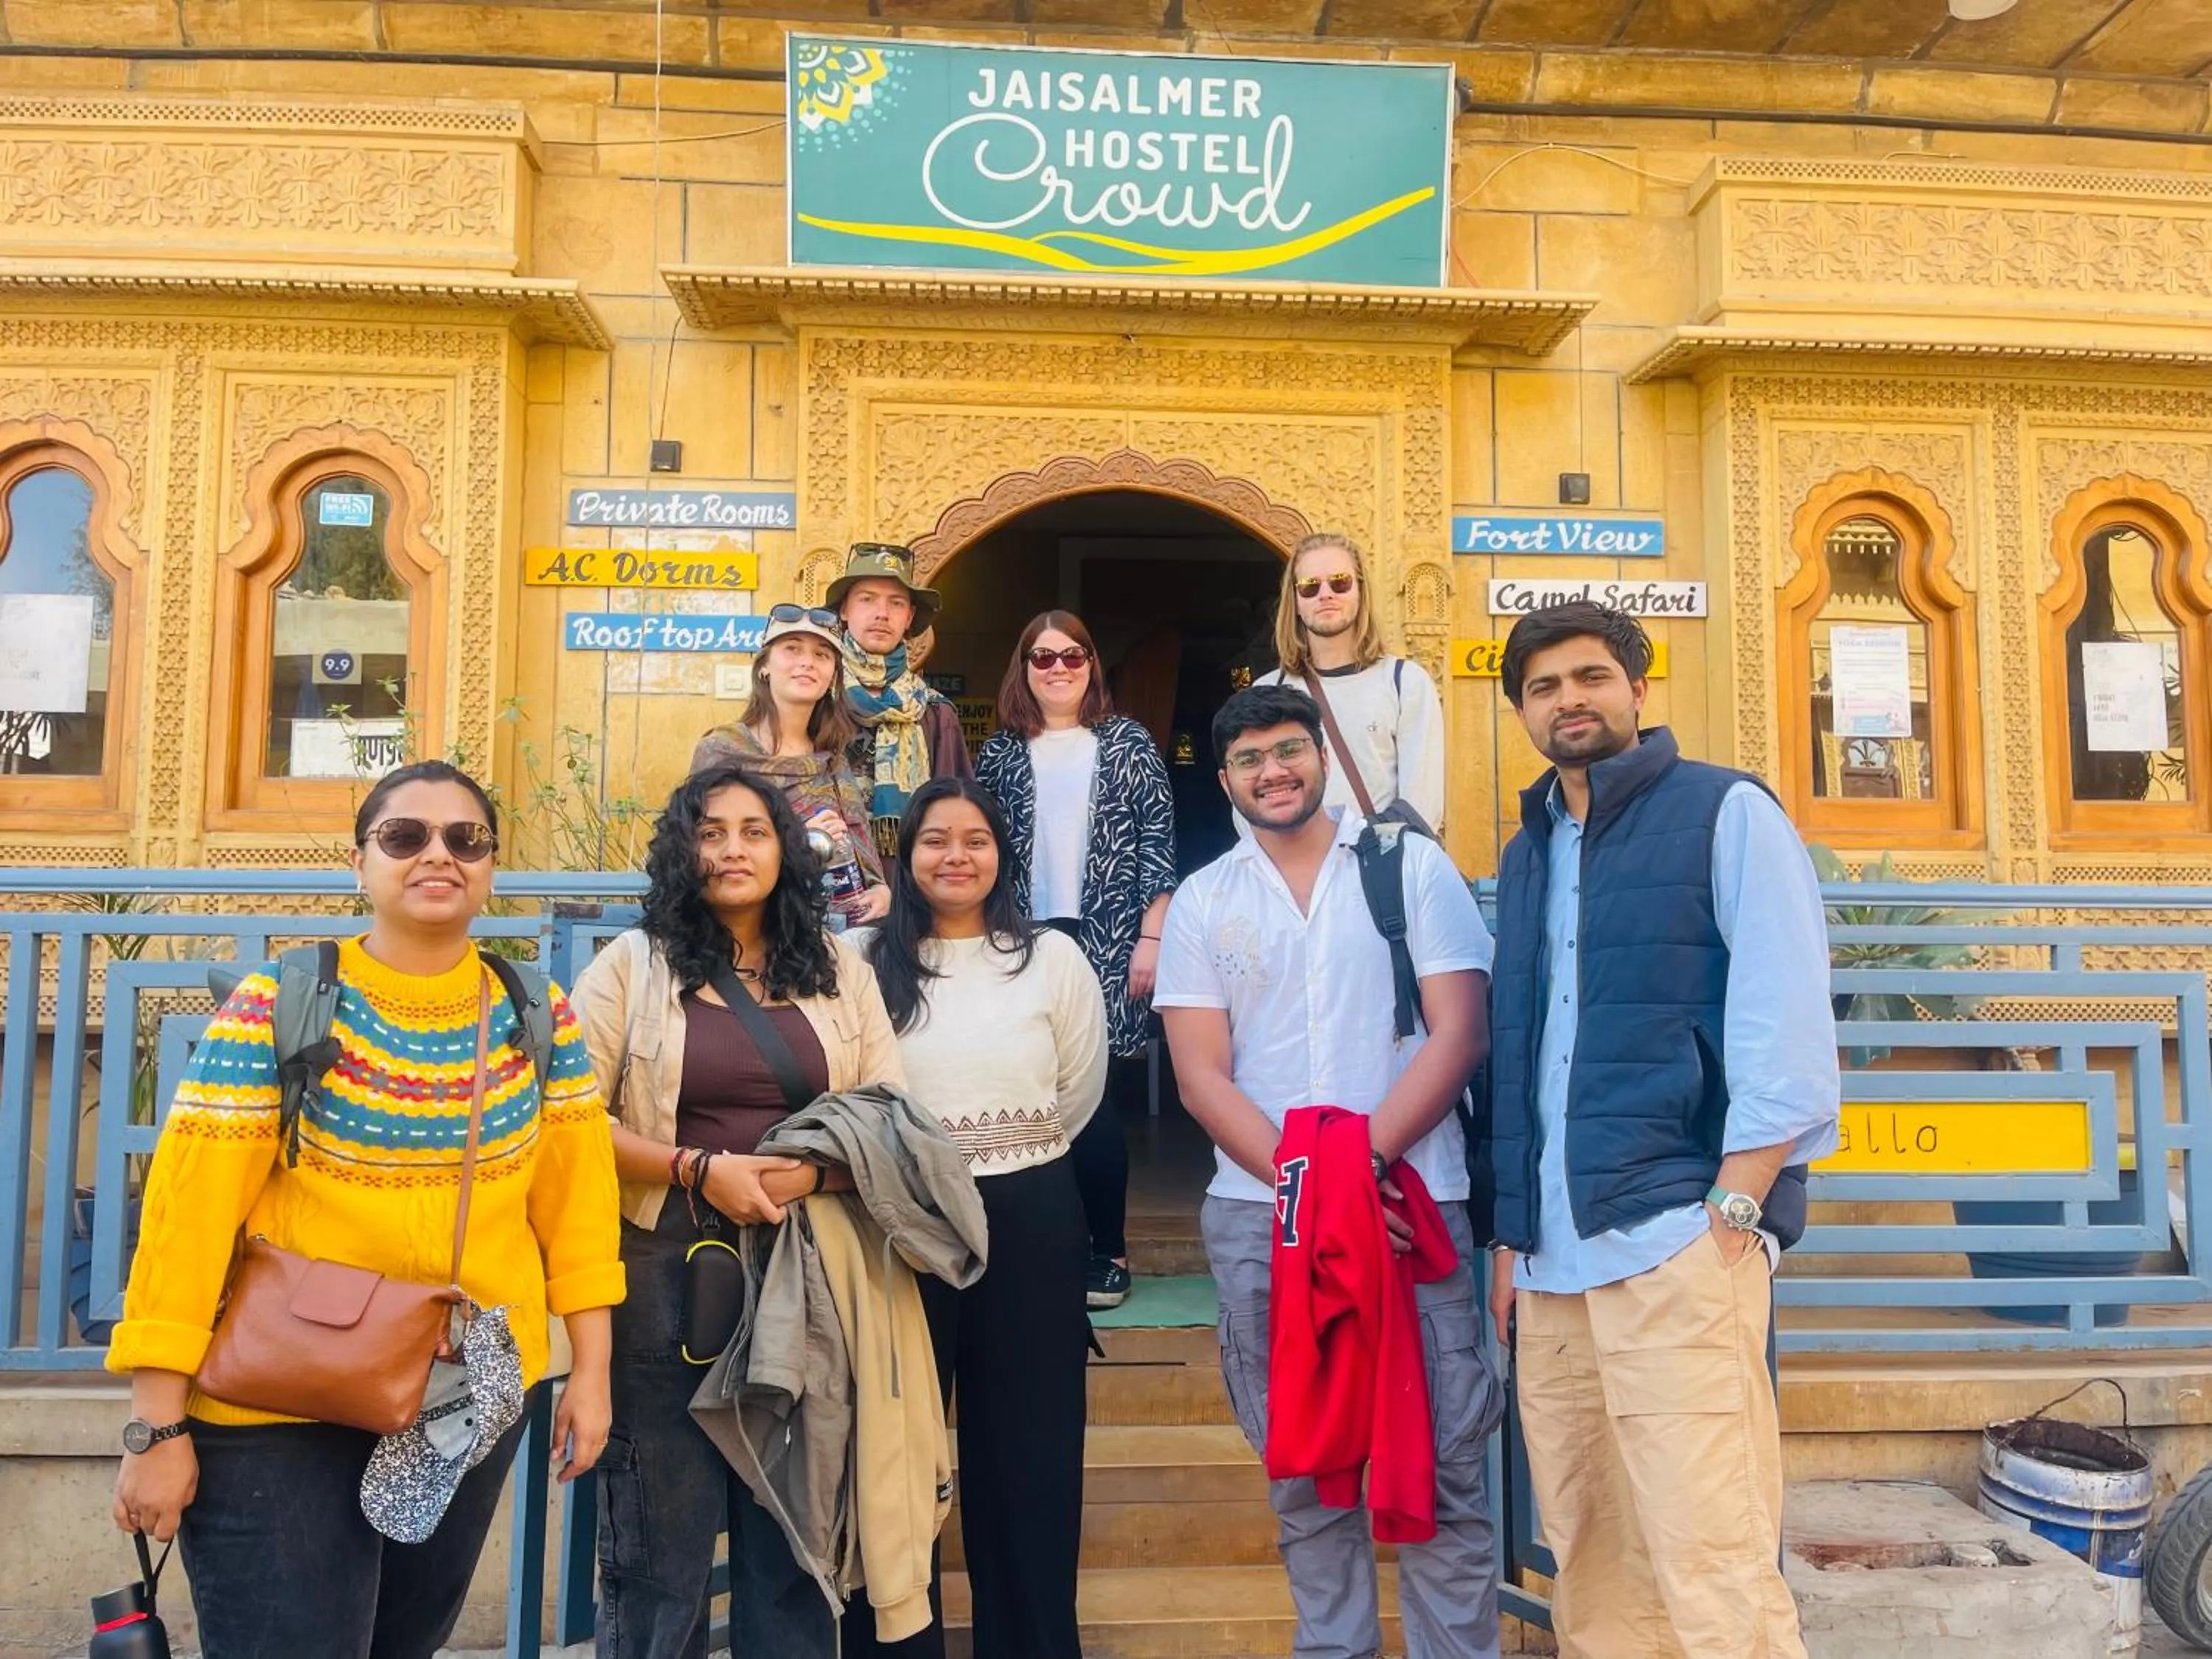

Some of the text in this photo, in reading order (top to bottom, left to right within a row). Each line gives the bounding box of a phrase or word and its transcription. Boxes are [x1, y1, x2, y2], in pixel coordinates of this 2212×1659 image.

[968, 69, 1262, 118] JAISALMER
[1065, 128, 1260, 174] HOSTEL
[922, 112, 1312, 231] Crowd
[576, 491, 791, 526] Private Rooms
[1467, 520, 1655, 552] Fort View
[613, 552, 745, 587] Dorms
[1603, 584, 1698, 613] Safari
[714, 618, 765, 648] Are
[325, 658, 350, 671] 9.9
[961, 723, 989, 736] THE
[1836, 1112, 1938, 1153] allo
